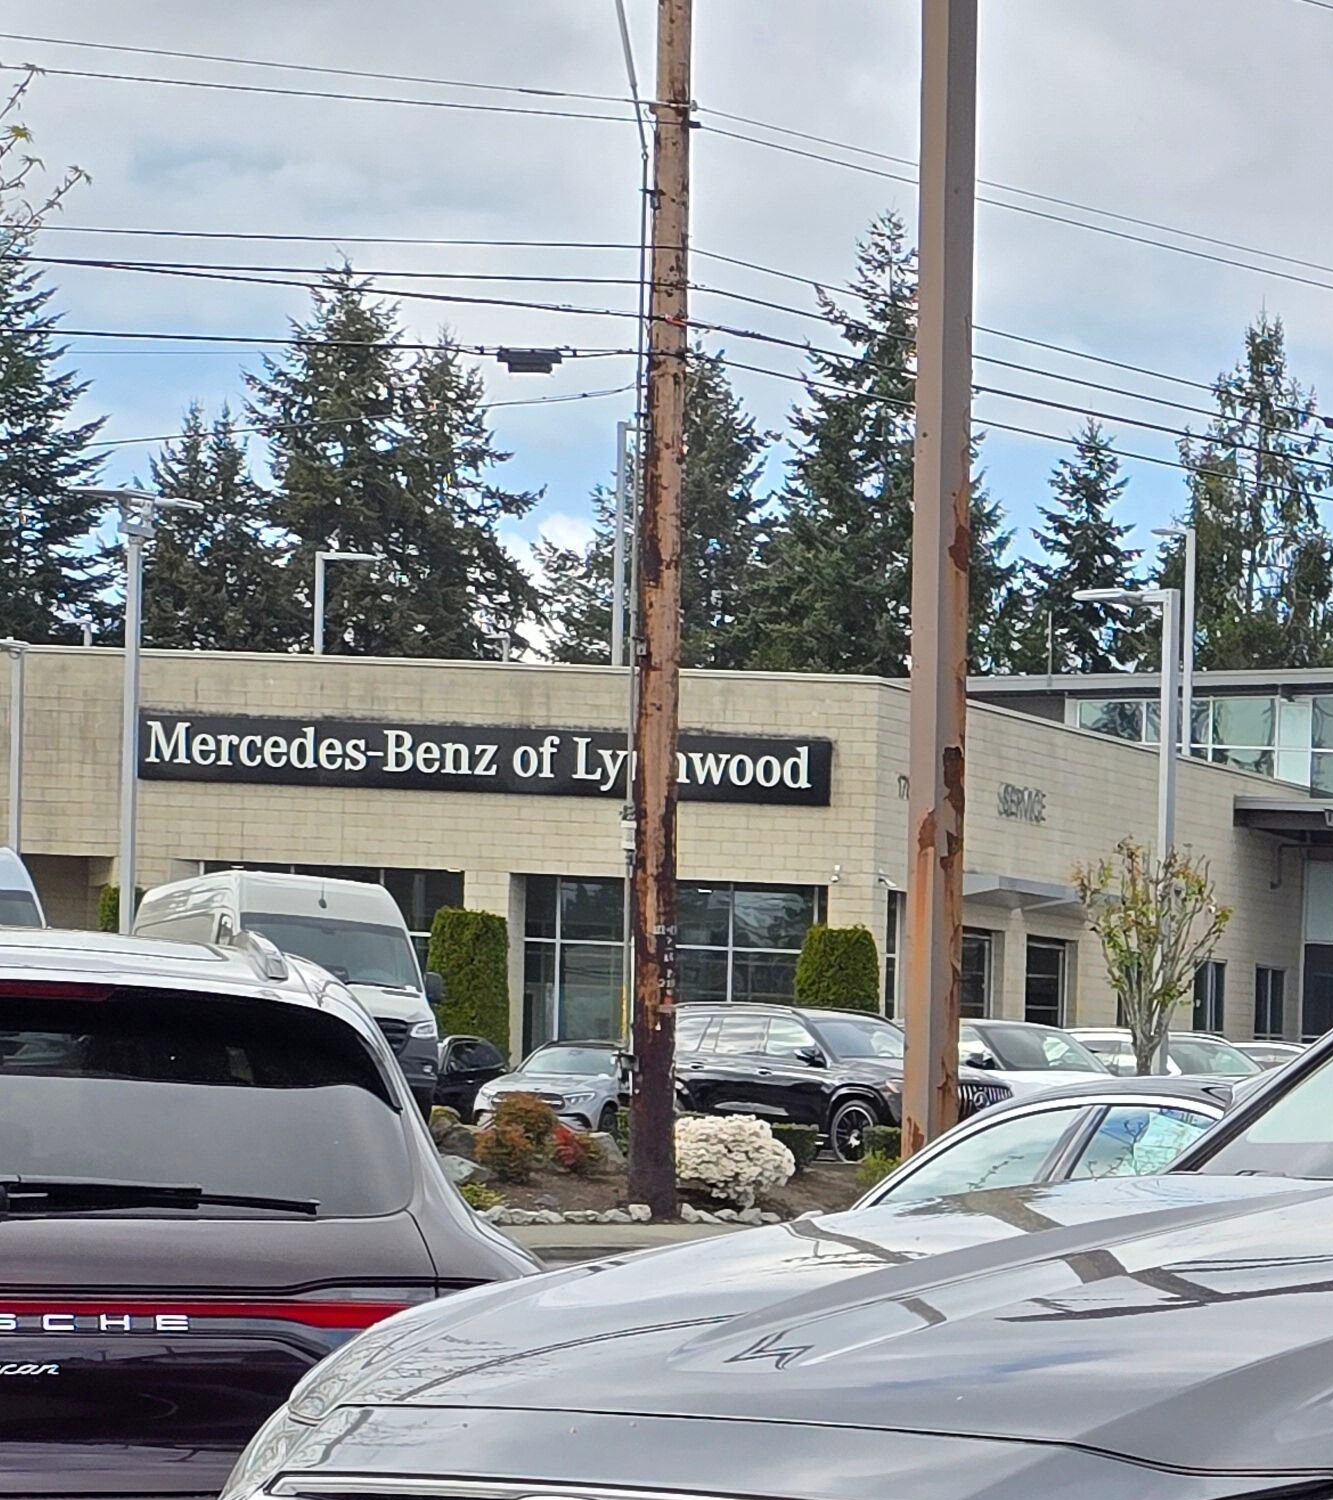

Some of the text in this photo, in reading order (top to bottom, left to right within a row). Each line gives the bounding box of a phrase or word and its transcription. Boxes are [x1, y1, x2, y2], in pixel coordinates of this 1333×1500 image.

[145, 720, 811, 792] Mercedes-Benz of Lywood
